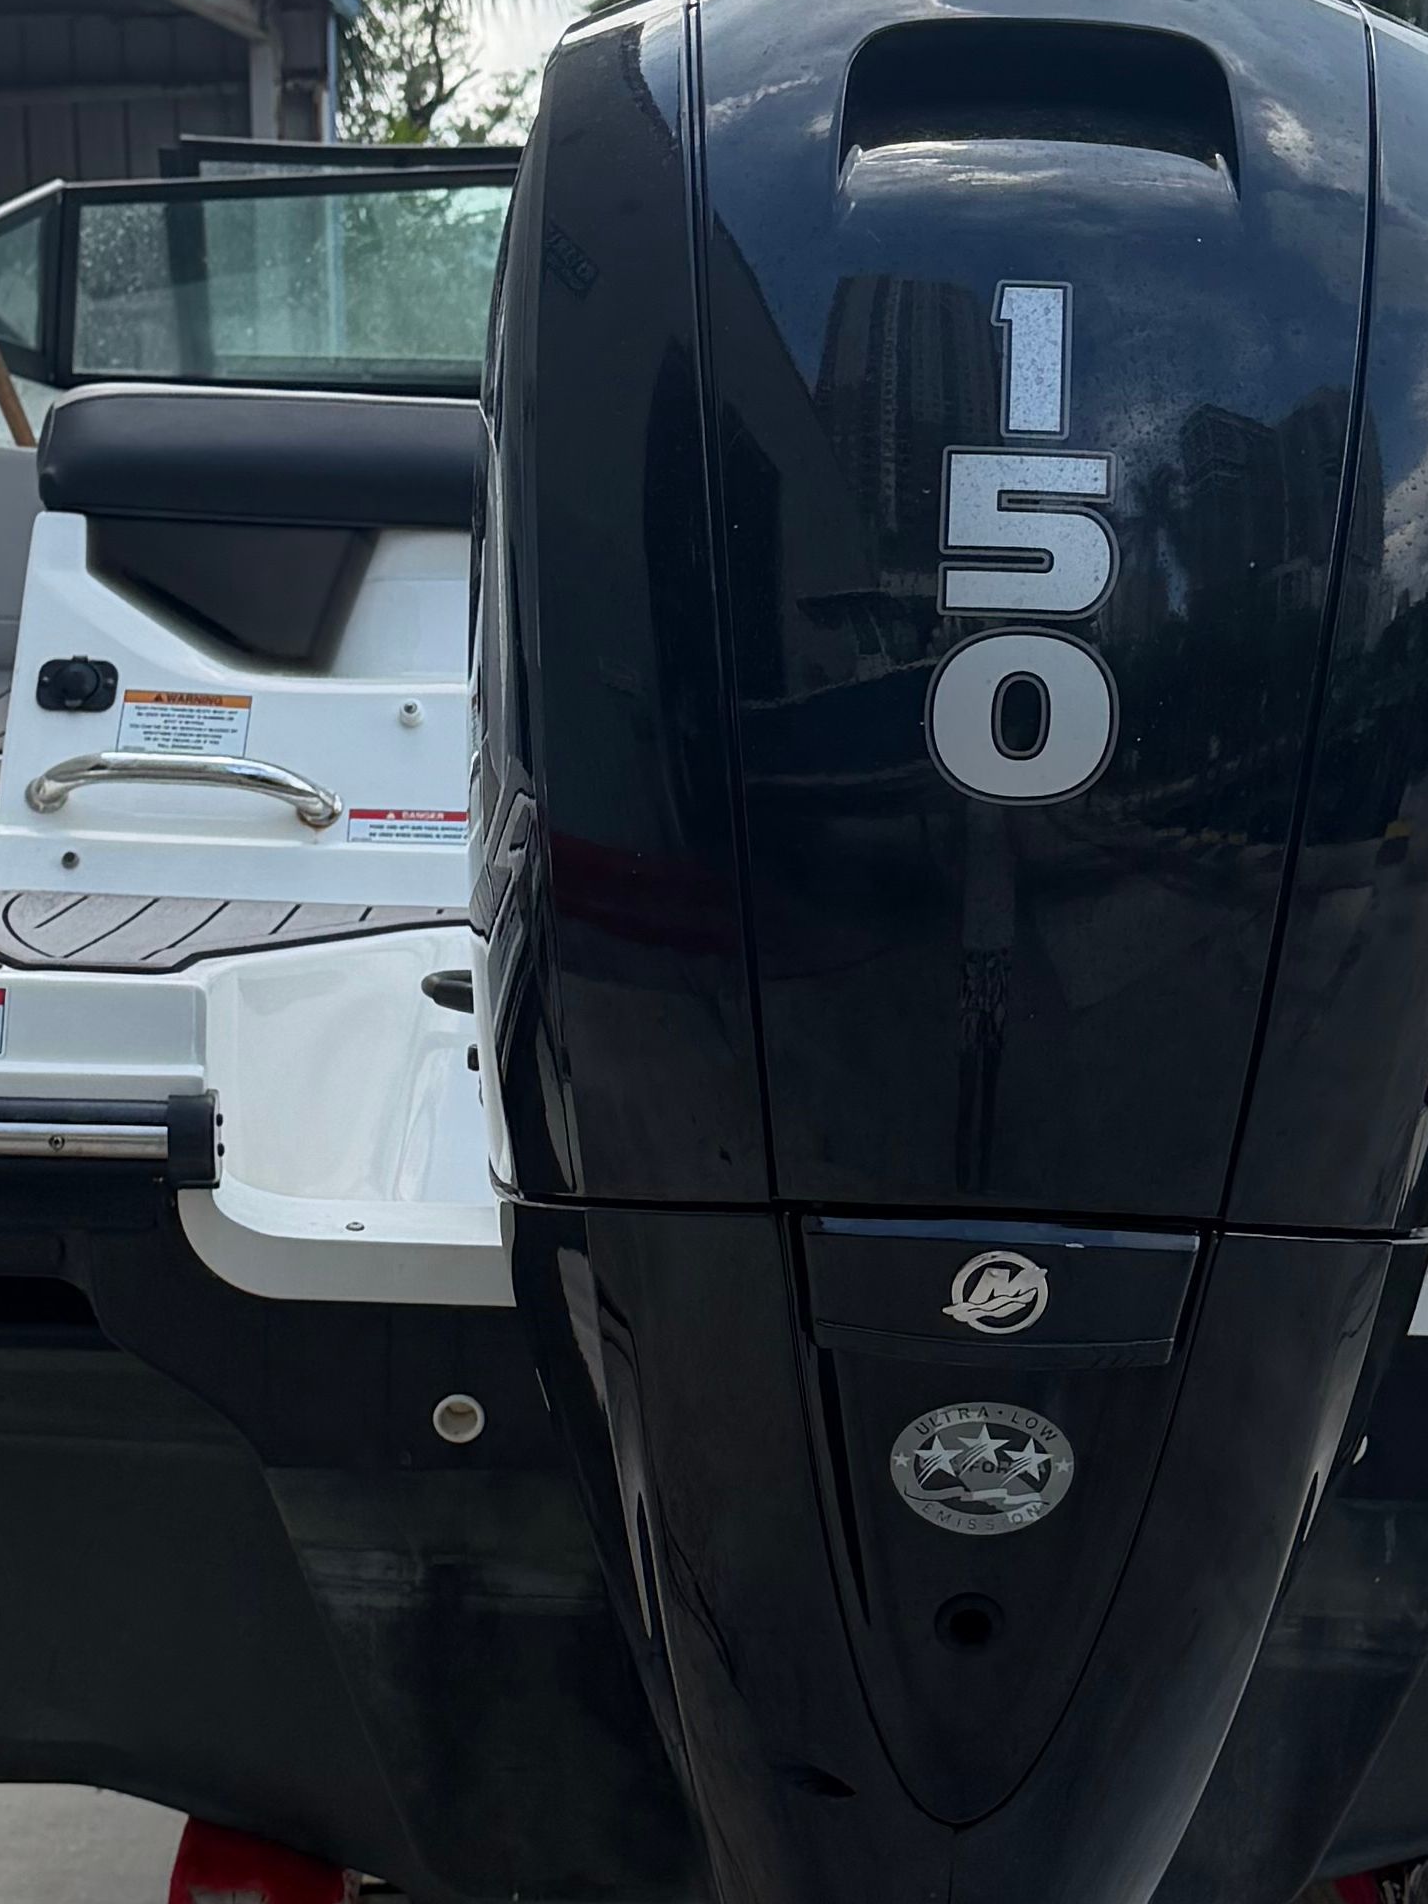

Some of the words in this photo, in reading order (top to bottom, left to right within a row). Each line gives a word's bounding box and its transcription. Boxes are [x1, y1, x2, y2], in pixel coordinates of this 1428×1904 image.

[924, 279, 1121, 807] 150
[166, 693, 223, 707] WARNING
[915, 1405, 990, 1437] ULTRA
[1010, 1411, 1059, 1442] LOW
